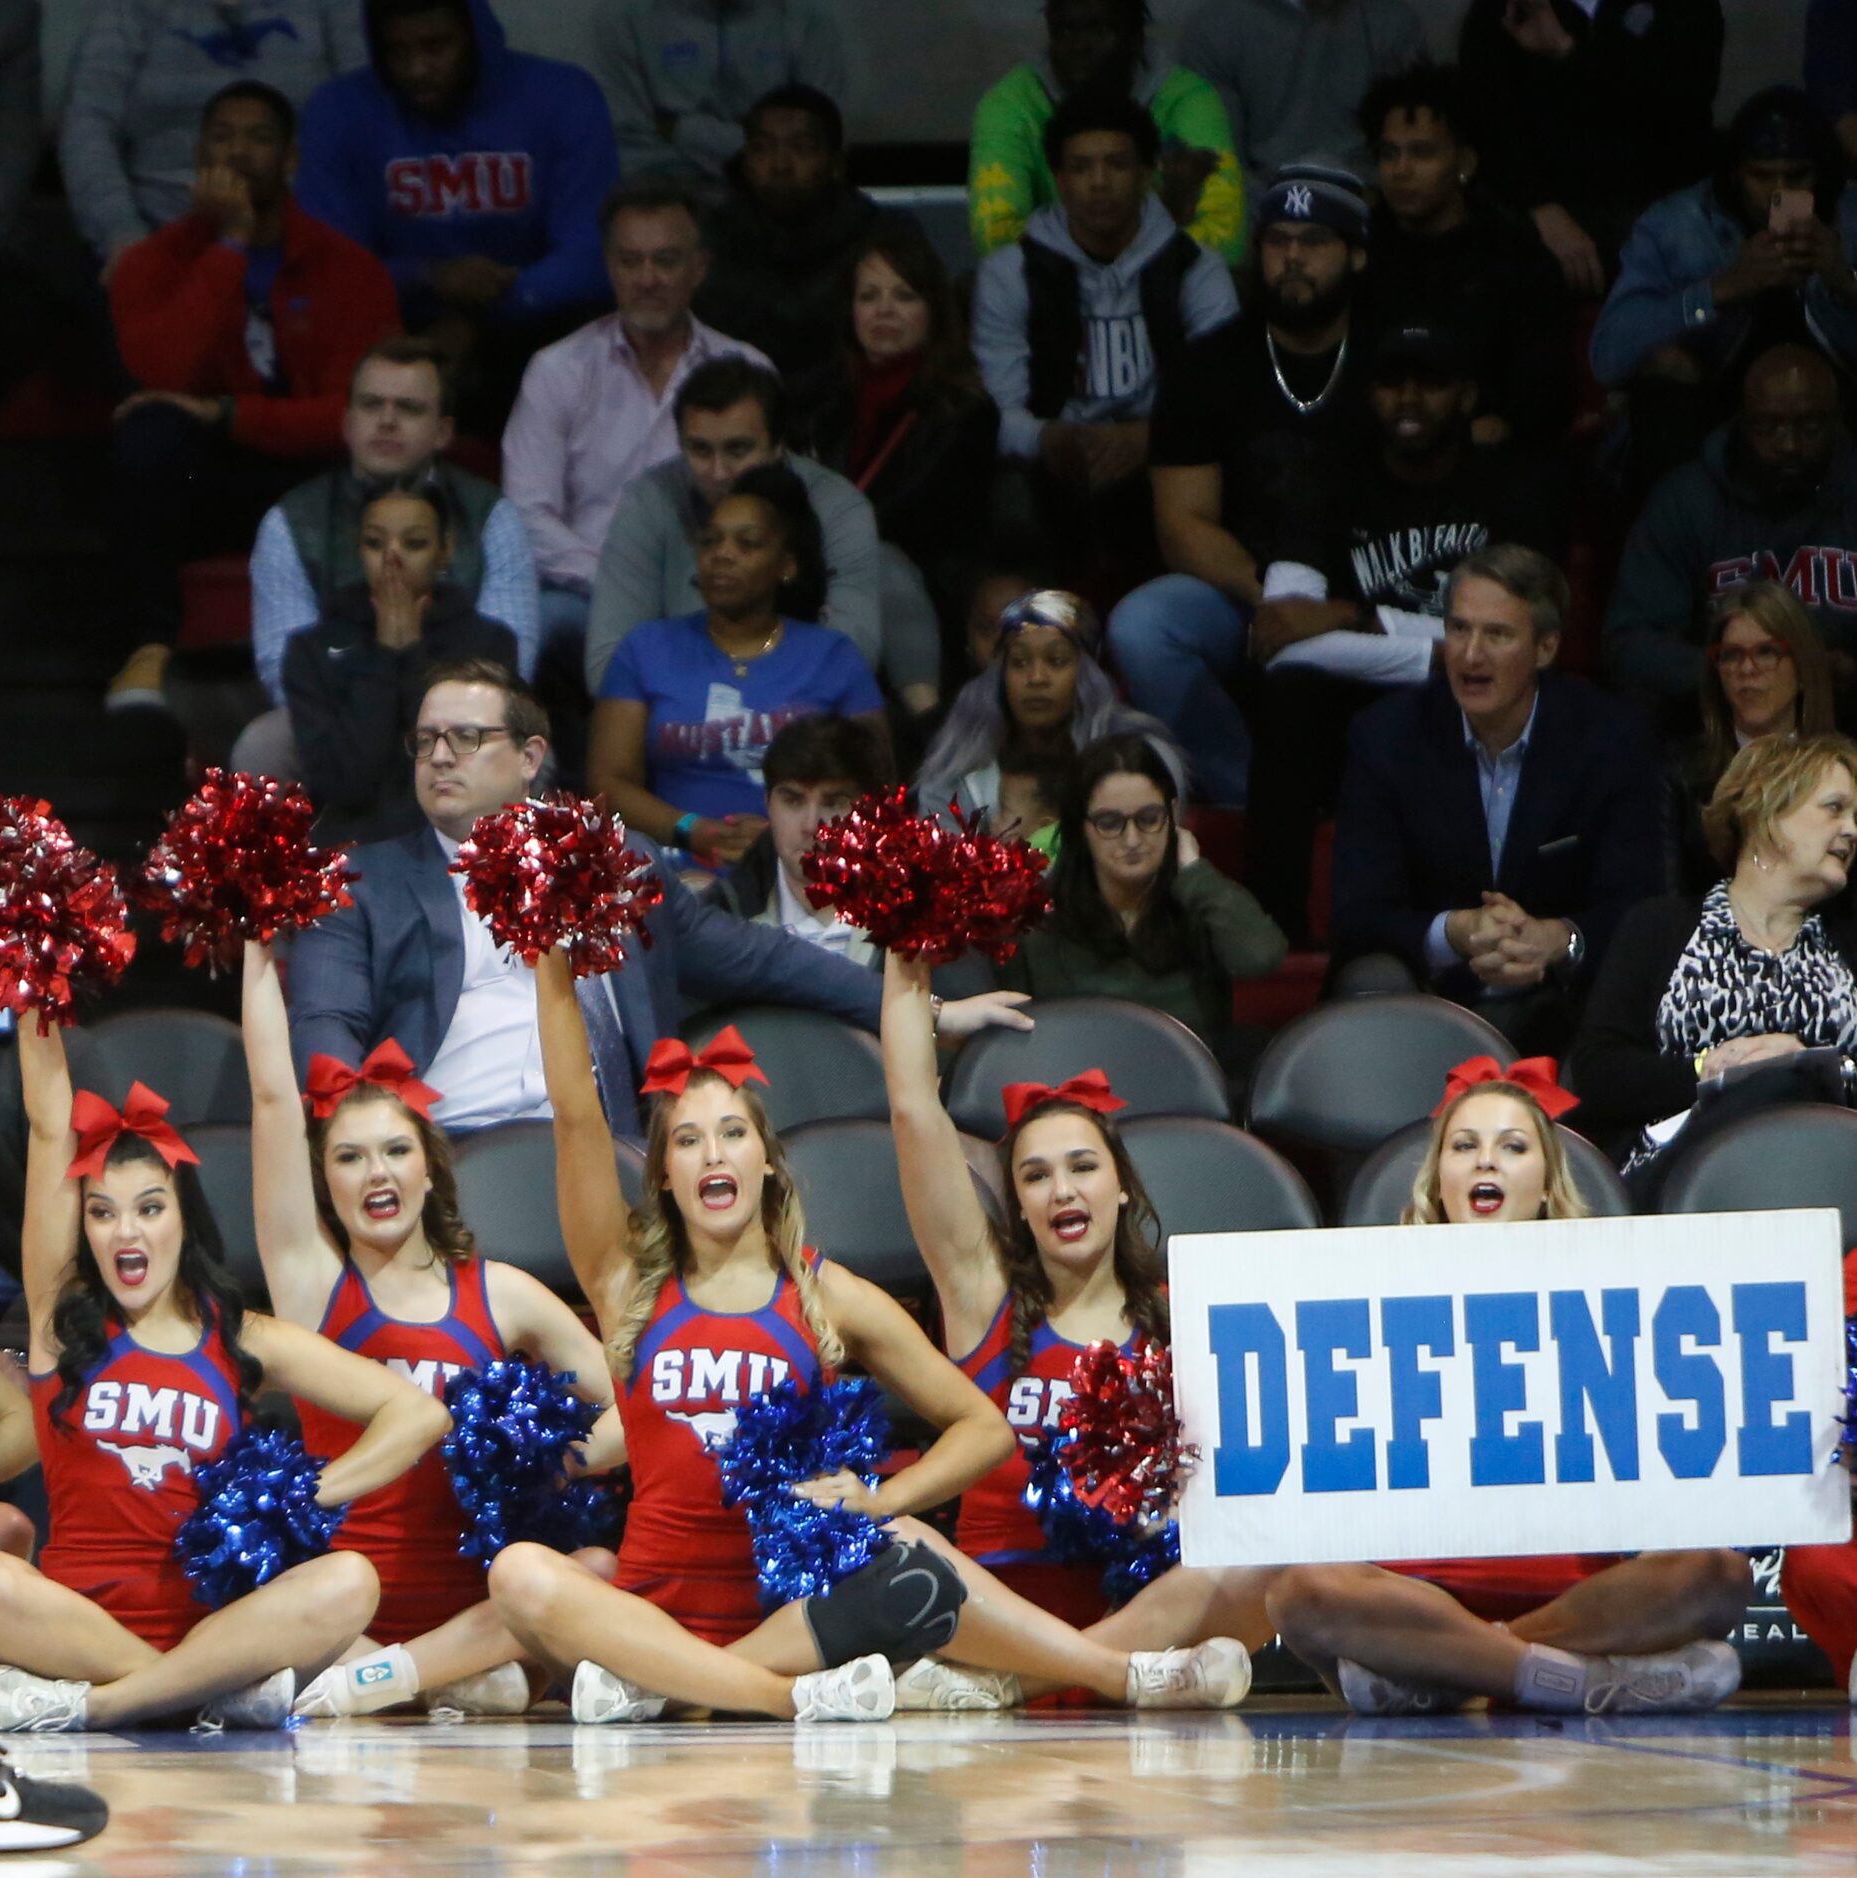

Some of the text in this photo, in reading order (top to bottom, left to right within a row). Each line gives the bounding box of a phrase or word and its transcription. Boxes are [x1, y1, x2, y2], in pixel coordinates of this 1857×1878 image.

[385, 151, 533, 217] SMU
[652, 1347, 789, 1403] SMU
[1208, 1281, 1814, 1497] DEFENSE
[83, 1381, 220, 1450] SMU
[1727, 1623, 1811, 1641] EAL
